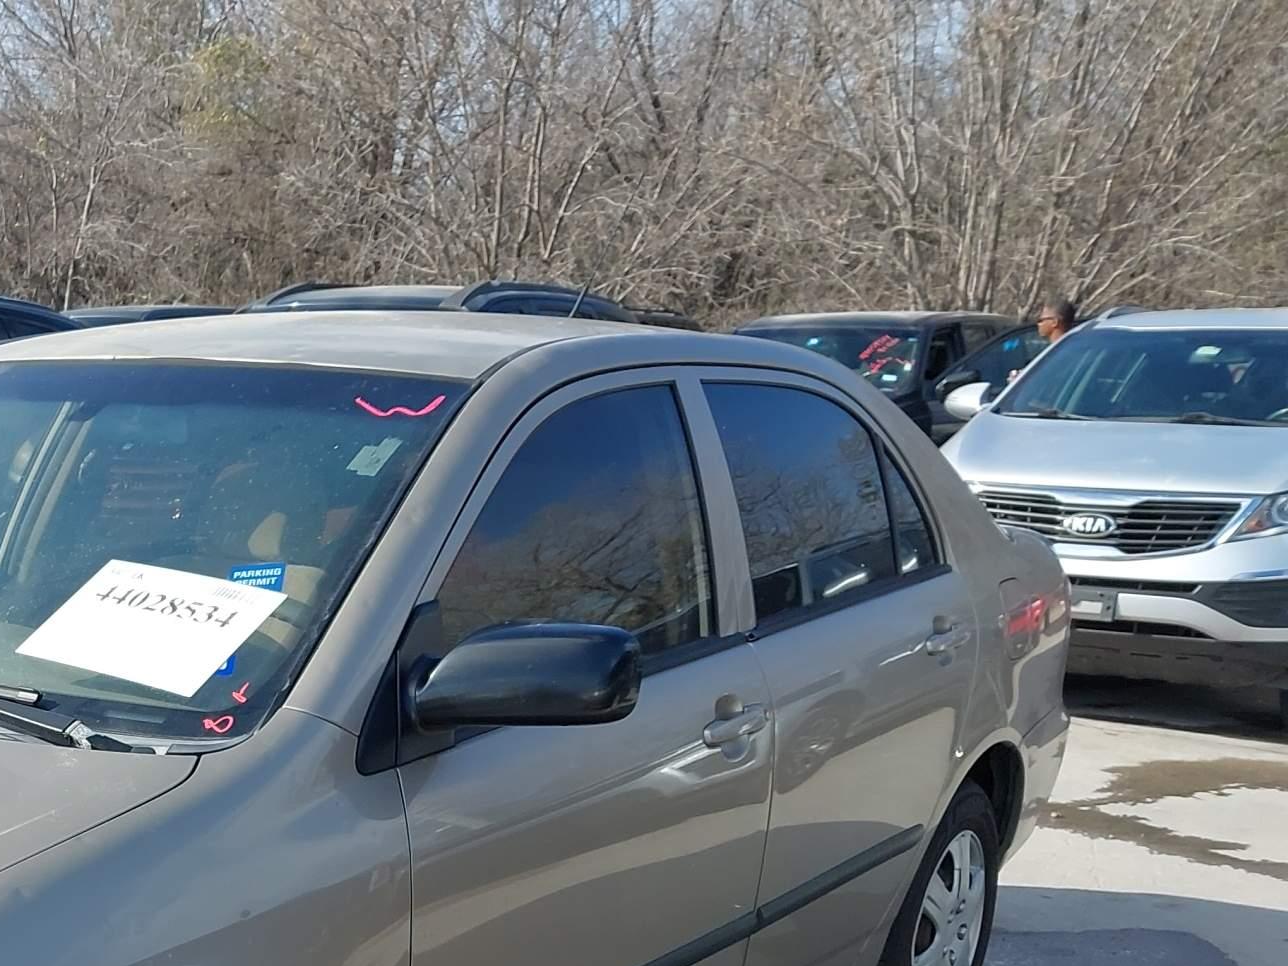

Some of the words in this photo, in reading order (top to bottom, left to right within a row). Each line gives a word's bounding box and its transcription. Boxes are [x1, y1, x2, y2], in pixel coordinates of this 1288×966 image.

[1071, 517, 1106, 533] KIA
[233, 567, 282, 579] PARKING
[96, 585, 239, 628] 44028534
